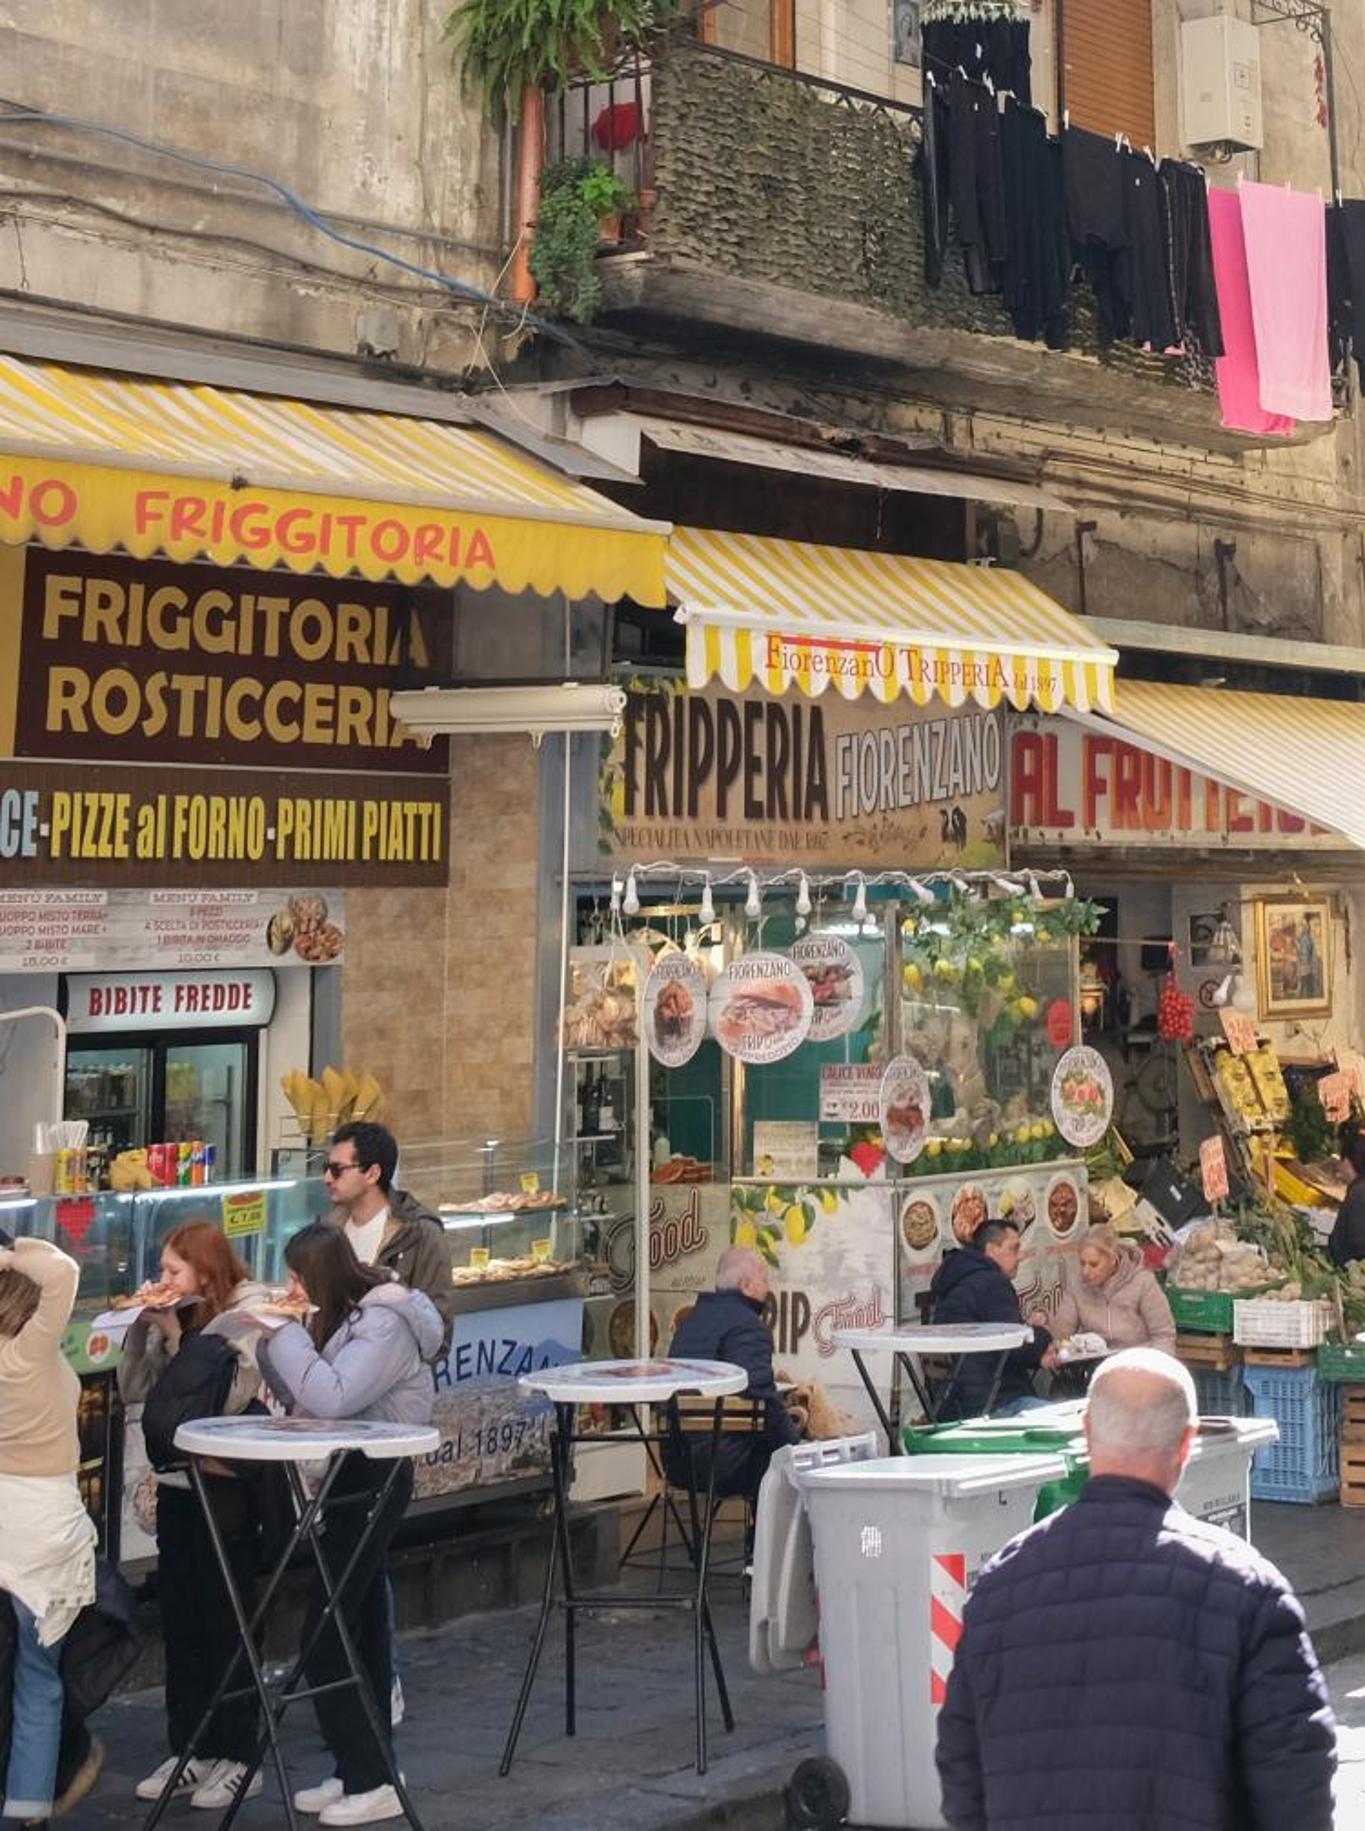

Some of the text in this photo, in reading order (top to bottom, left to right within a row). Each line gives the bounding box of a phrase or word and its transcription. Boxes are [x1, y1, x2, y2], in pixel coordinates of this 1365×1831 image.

[135, 491, 496, 570] FRIGGITORIA
[835, 712, 1000, 820] FIORENZANO
[1010, 730, 1075, 828] AL
[138, 794, 165, 859] al
[276, 798, 356, 860] PRIMI
[362, 800, 441, 861] PIATTI
[88, 982, 253, 1017] BIBITE FREDDE
[728, 962, 793, 980] FIORENZANO
[475, 1420, 528, 1459] 1897
